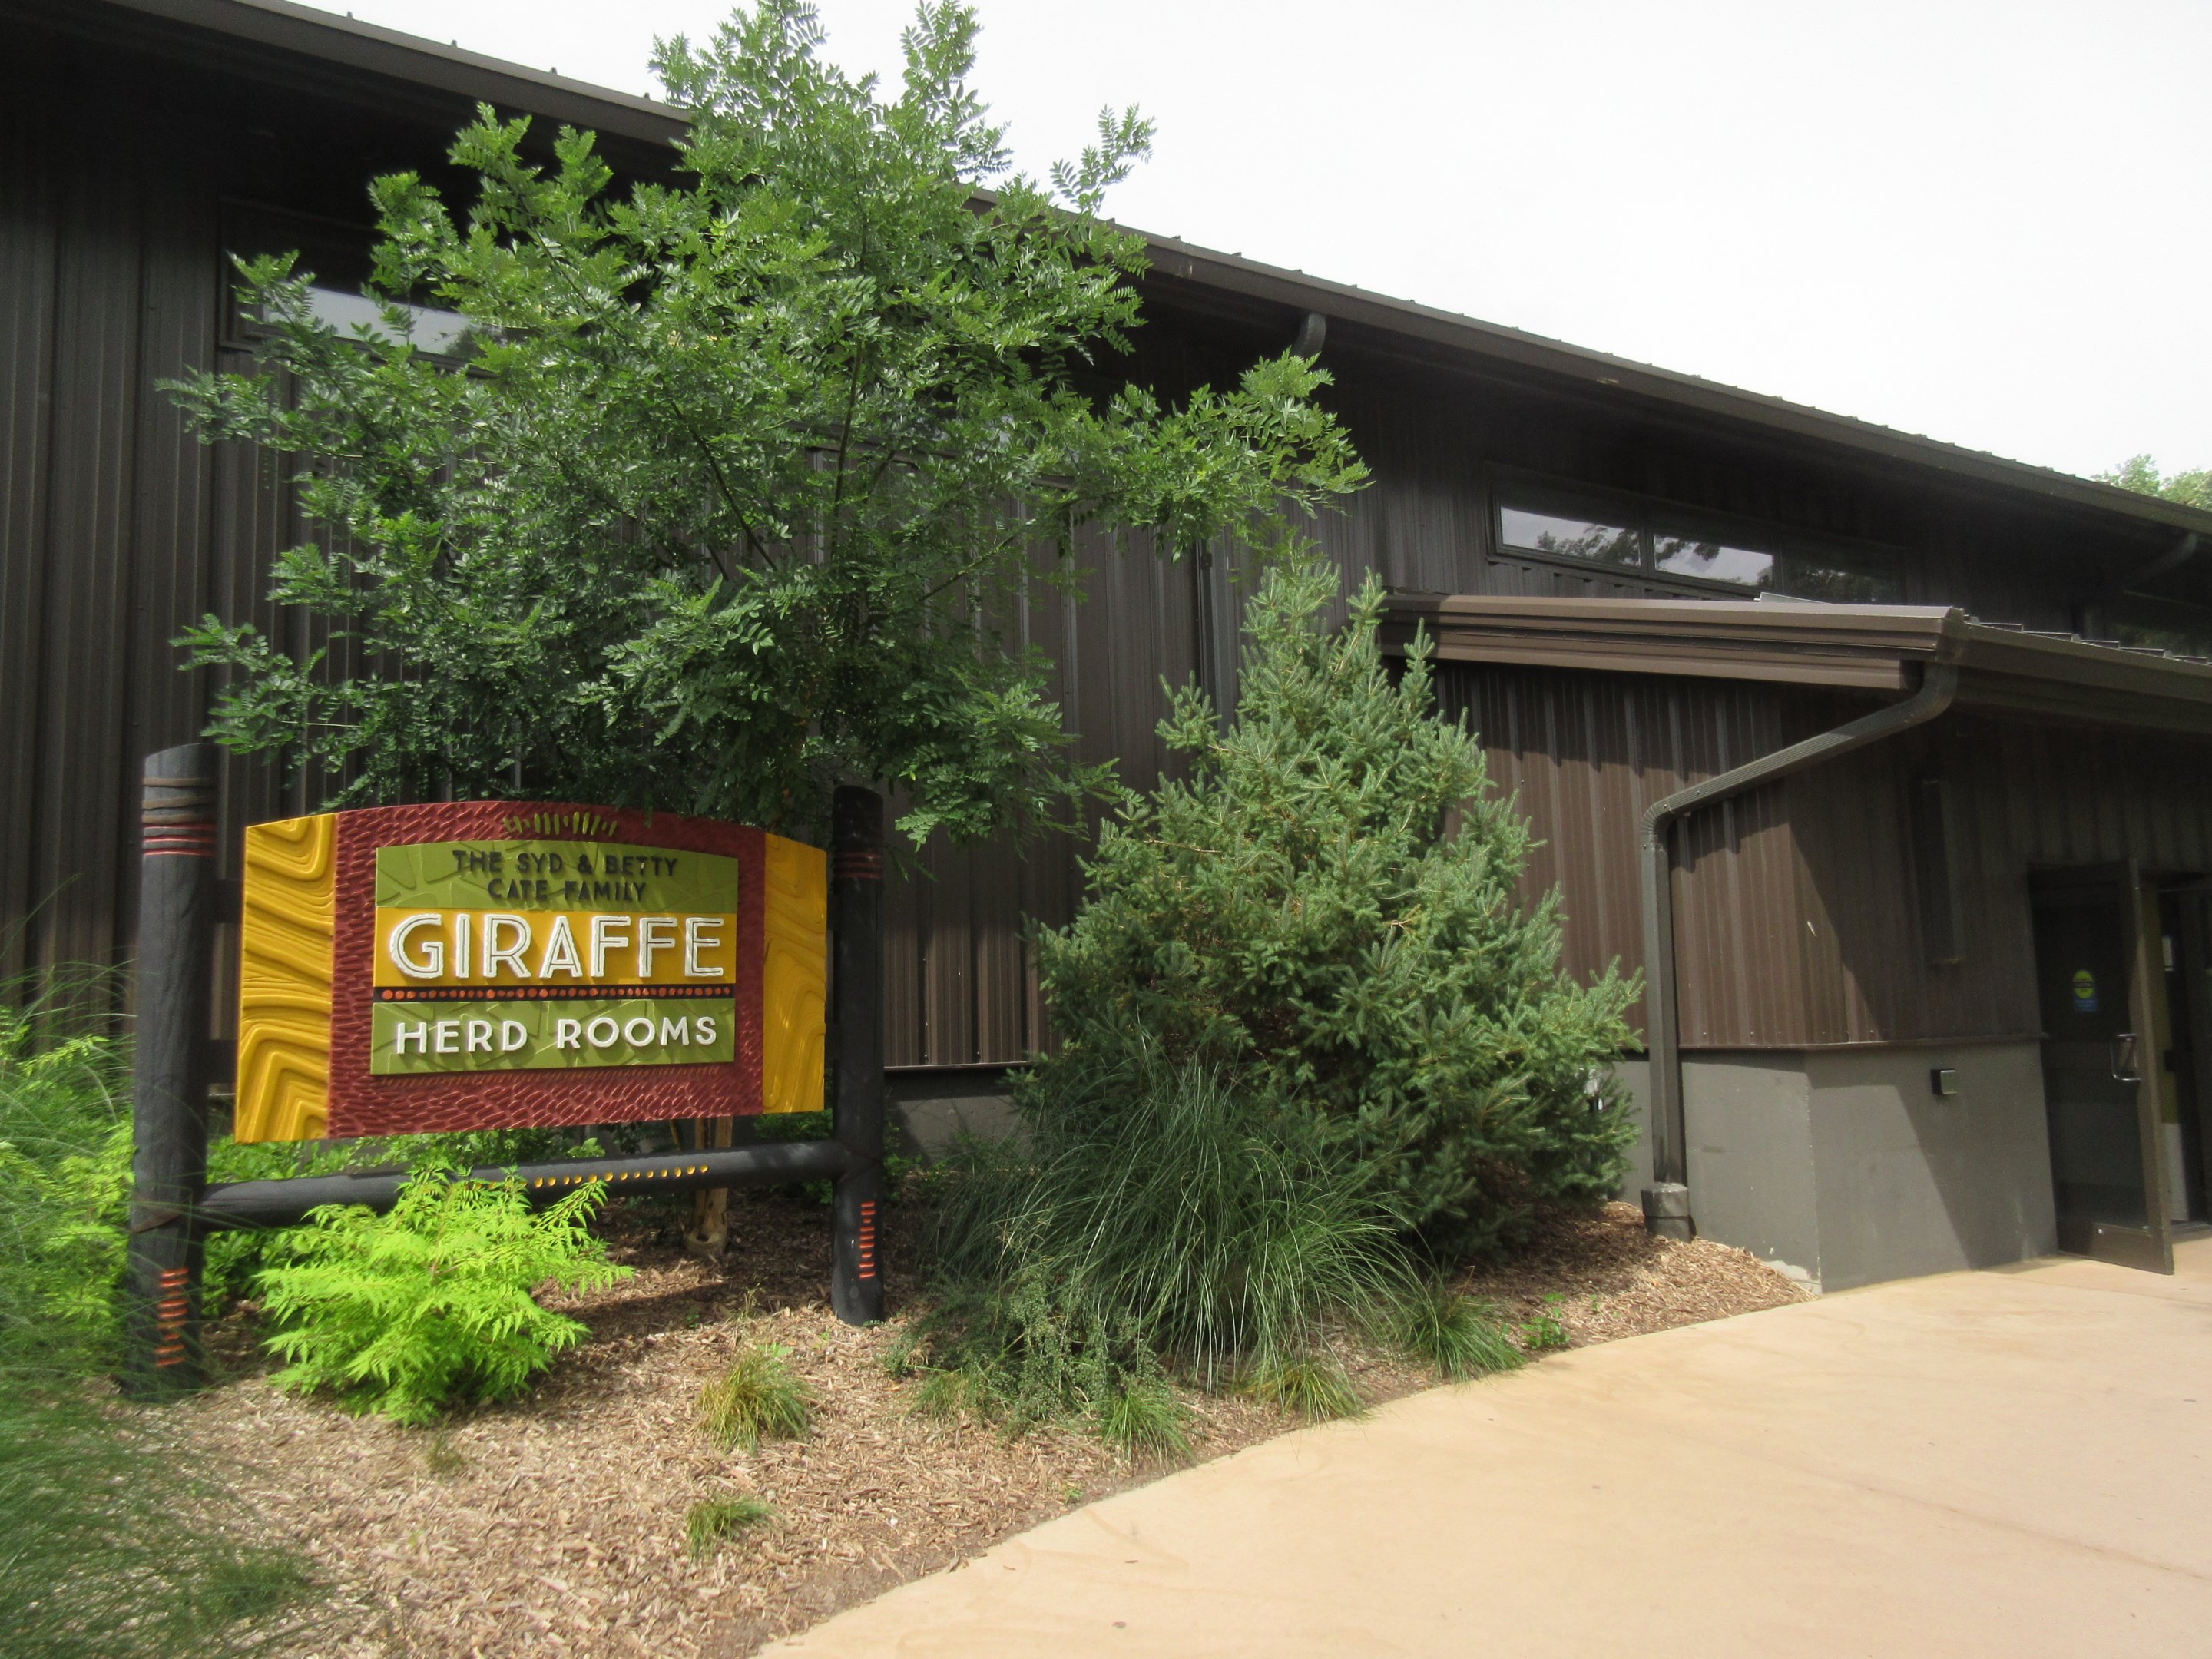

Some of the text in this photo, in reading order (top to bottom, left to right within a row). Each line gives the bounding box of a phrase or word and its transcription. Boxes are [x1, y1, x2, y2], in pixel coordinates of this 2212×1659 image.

[452, 850, 679, 876] THE SYD & BETTY
[488, 879, 647, 902] CATE FAMILY
[389, 912, 724, 979] GIRAFFE
[396, 1015, 717, 1055] HERD ROOMS
